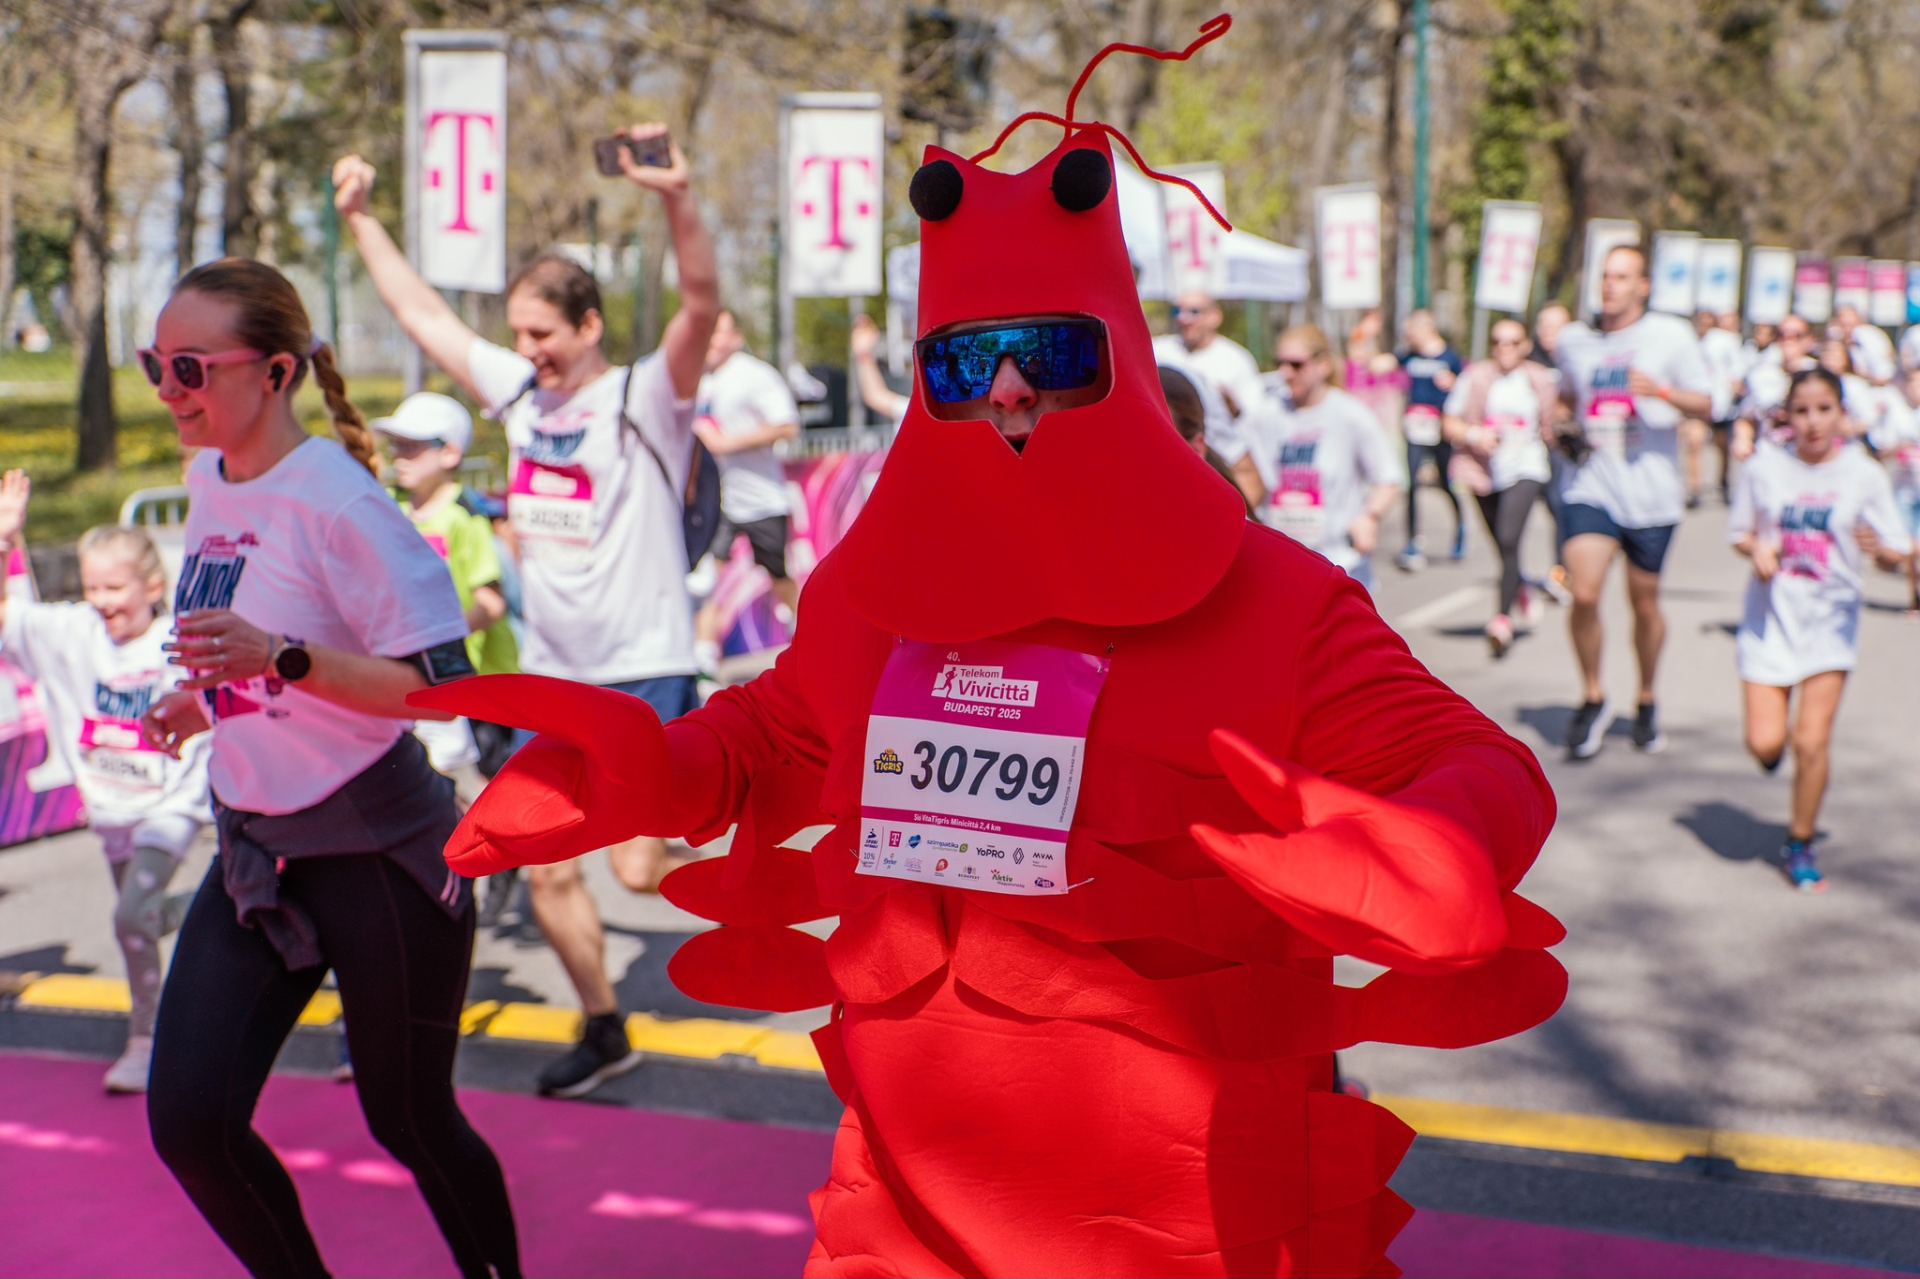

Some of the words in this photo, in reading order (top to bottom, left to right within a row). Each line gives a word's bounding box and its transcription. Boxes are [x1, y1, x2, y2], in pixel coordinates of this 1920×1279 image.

[424, 112, 500, 233] T
[798, 156, 878, 253] T
[946, 651, 961, 663] 40.
[960, 668, 1000, 679] Telekom
[958, 679, 1030, 702] Vivicittá
[943, 701, 996, 718] BUDAPEST
[998, 707, 1021, 720] 2025
[874, 760, 902, 773] TIGRIS
[910, 740, 1060, 806] 30799
[990, 823, 1001, 832] km
[891, 832, 900, 846] T
[976, 847, 1005, 859] YoPRO
[1032, 852, 1054, 861] MVM
